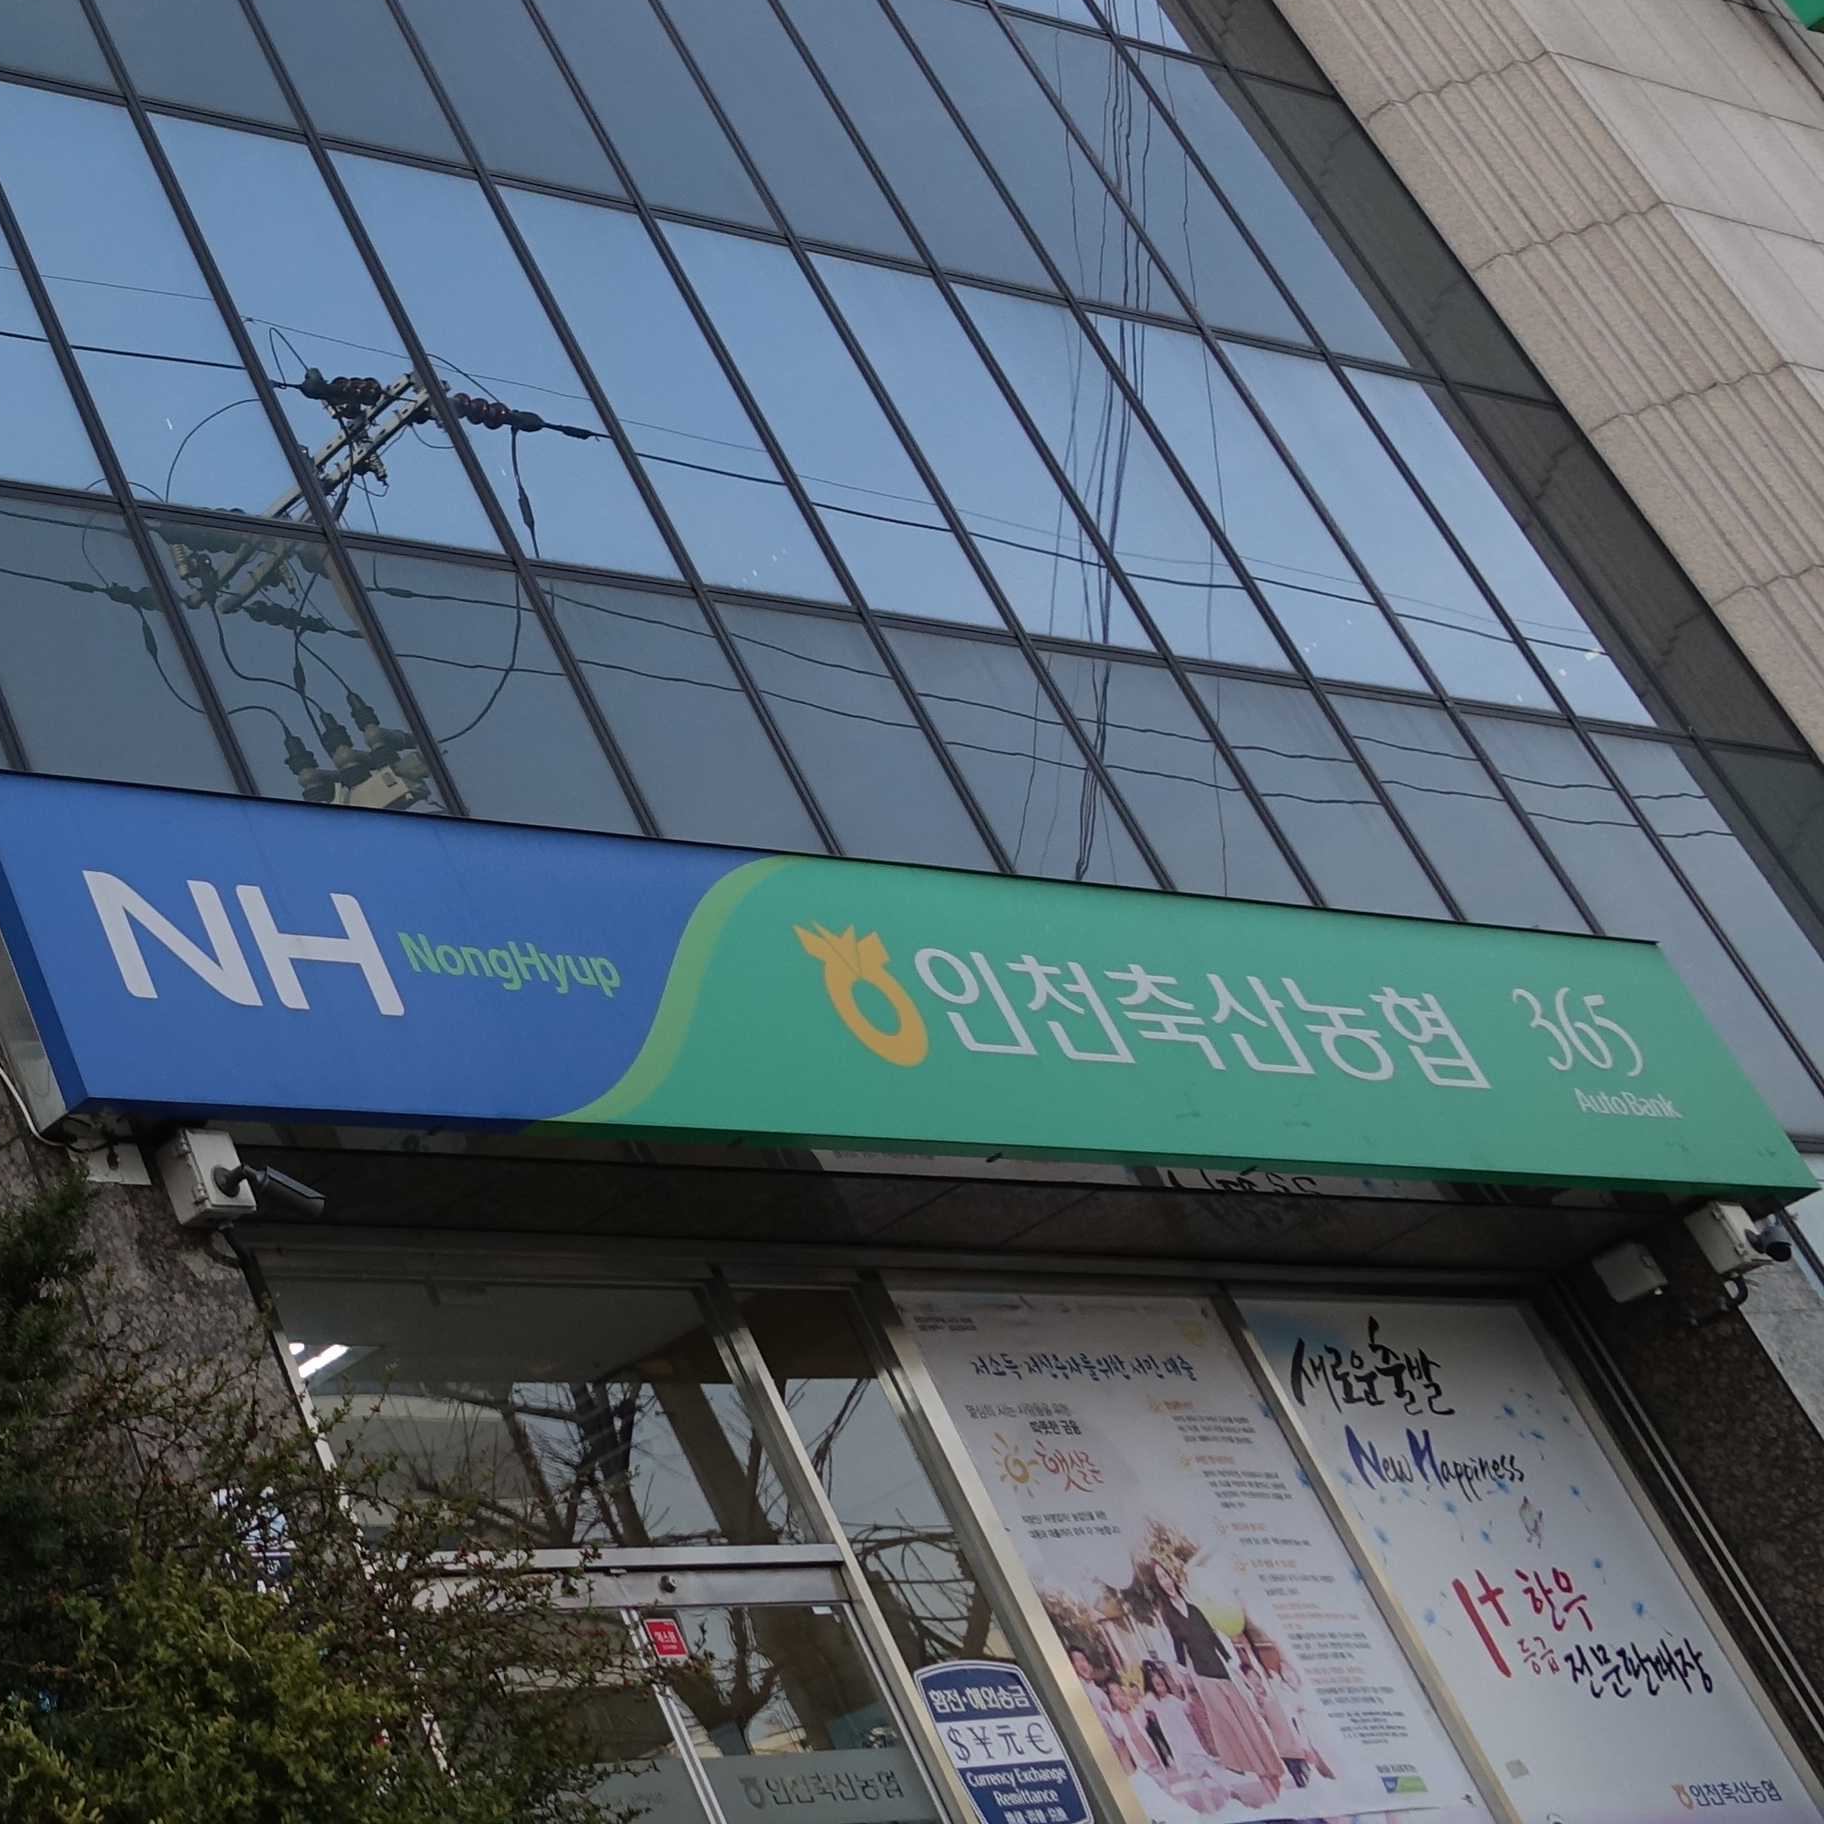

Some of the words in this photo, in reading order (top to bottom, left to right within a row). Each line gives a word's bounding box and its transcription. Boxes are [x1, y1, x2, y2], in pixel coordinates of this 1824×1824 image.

[82, 868, 405, 1017] NH
[397, 932, 622, 998] NongHyup
[914, 947, 1493, 1091] 인천축산농협
[1511, 986, 1643, 1078] 365
[1345, 1425, 1414, 1489] New
[1406, 1428, 1525, 1503] Happiness
[1514, 1567, 1595, 1632] 한우
[966, 1772, 1017, 1788] Currency
[1013, 1766, 1068, 1785] Exchange
[993, 1788, 1060, 1807] Remittance
[1688, 1779, 1784, 1807] 인천축산농협
